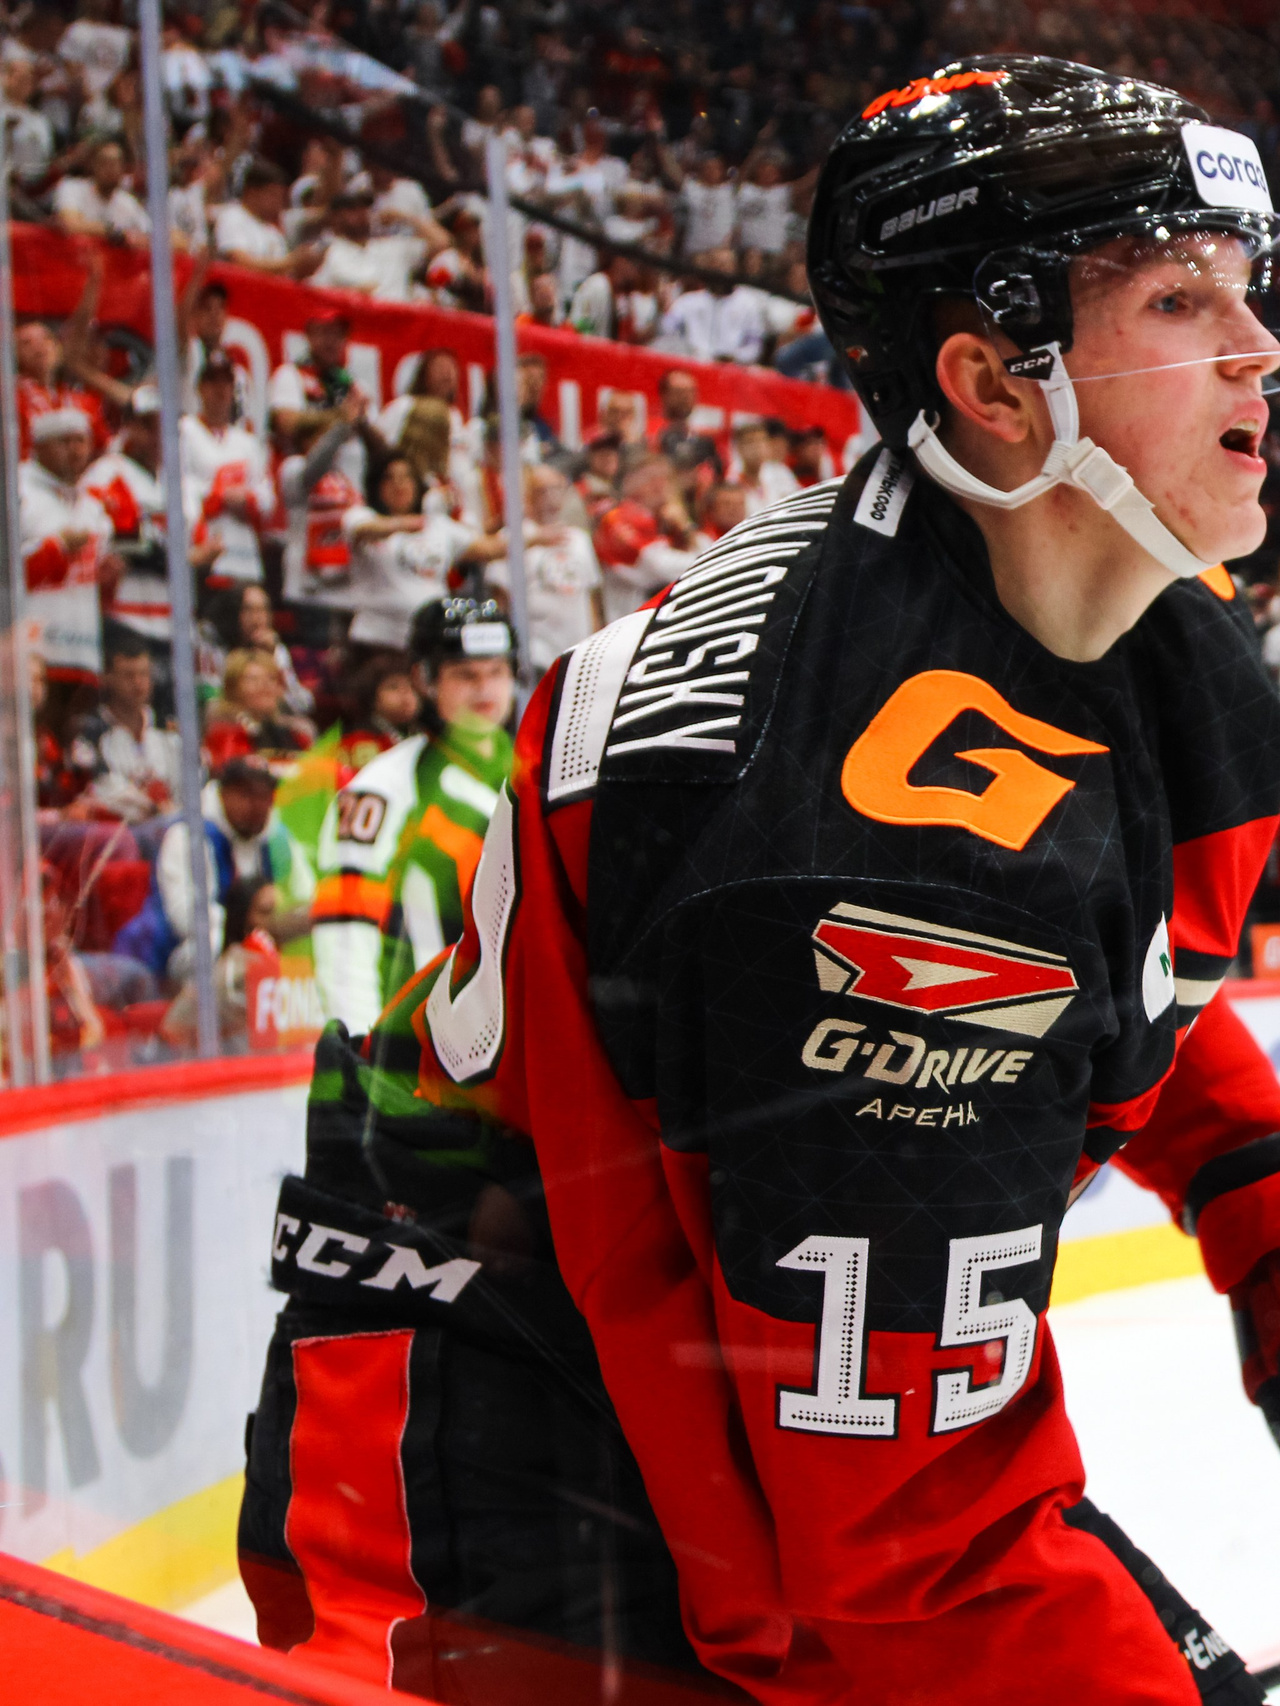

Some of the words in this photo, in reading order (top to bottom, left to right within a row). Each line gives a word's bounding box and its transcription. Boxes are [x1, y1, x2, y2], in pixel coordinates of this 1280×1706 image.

[880, 186, 979, 241] BAUER
[1010, 355, 1051, 373] CCM
[855, 1098, 980, 1129] АРЕНА
[271, 1211, 483, 1305] CCM
[776, 1224, 1044, 1440] 15
